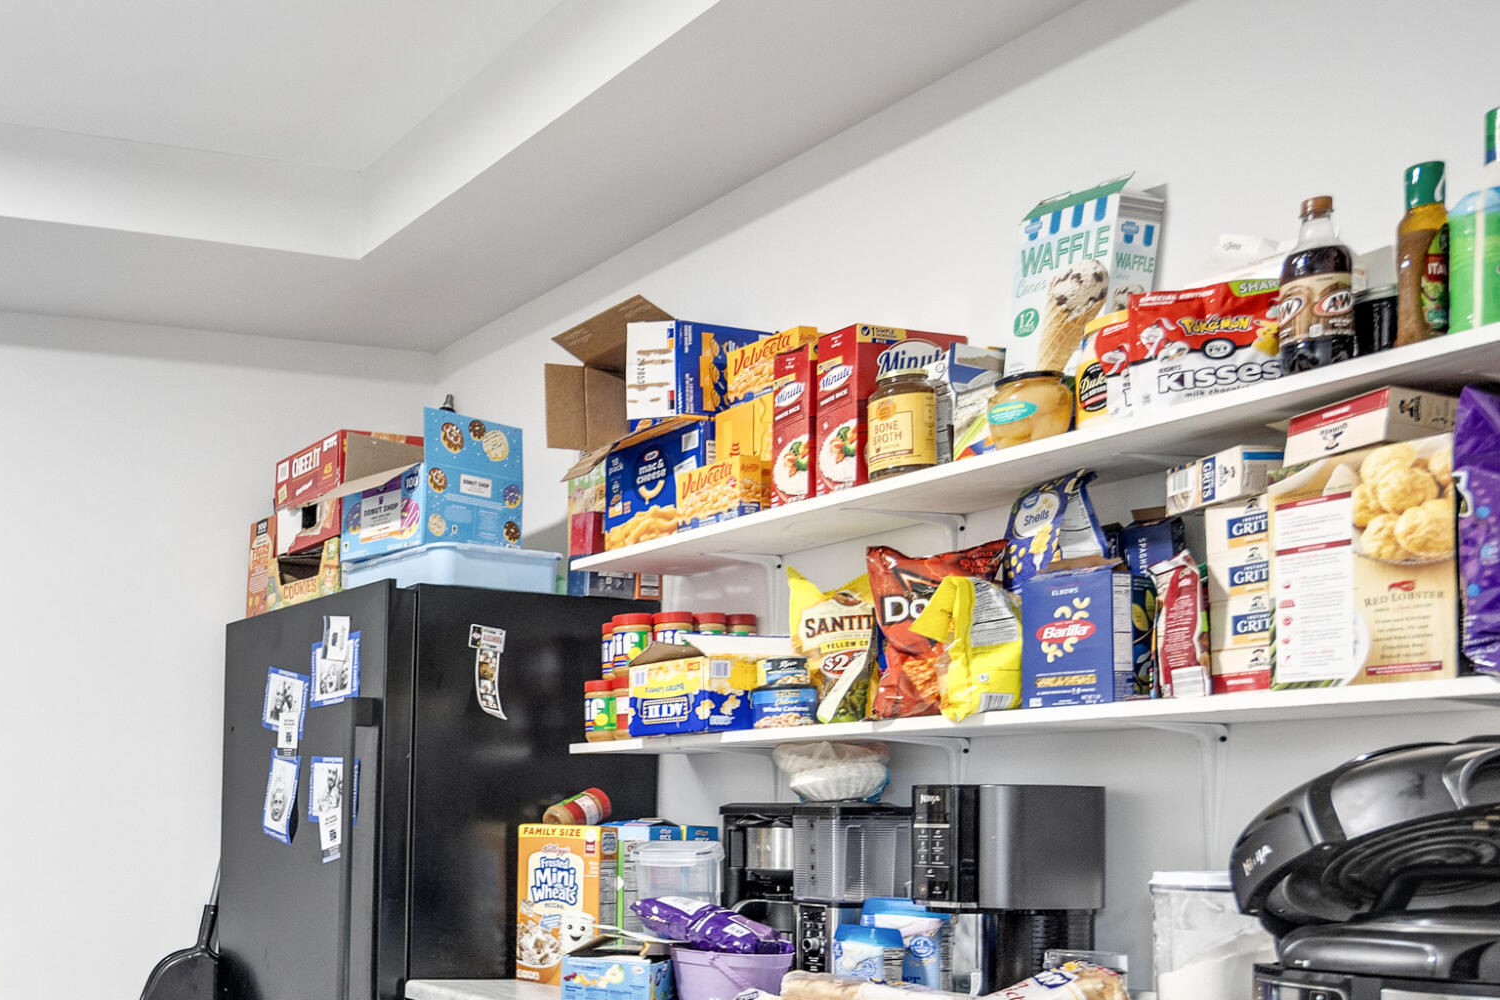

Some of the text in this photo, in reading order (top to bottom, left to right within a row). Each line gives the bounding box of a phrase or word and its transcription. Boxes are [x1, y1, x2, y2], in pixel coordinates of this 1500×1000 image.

[1020, 225, 1110, 278] WAFFLE
[1115, 252, 1154, 273] WAFFLE
[1428, 263, 1447, 276] ITA
[1239, 279, 1280, 295] SHAR
[1018, 310, 1035, 328] 12
[733, 334, 791, 376] Velveeta
[878, 348, 947, 376] Minut
[822, 366, 851, 389] Minute
[874, 420, 899, 435] BONE
[873, 430, 902, 446] BROTH
[682, 463, 733, 500] Velveeta
[1202, 461, 1213, 499] GRITS
[1023, 509, 1049, 526] Shells
[1231, 519, 1268, 536] GRIT
[1233, 568, 1269, 585] GRIT
[283, 578, 318, 600] COOKIES
[1391, 591, 1444, 602] LOBSTER
[804, 614, 873, 639] SANTIT
[1042, 623, 1093, 640] Barilla
[1236, 618, 1270, 634] GRIT
[826, 640, 857, 649] YELLOW
[647, 702, 684, 719] ACT II
[523, 827, 581, 837] FAMILY SIZE
[540, 856, 570, 869] Frosted
[534, 867, 576, 888] Mini
[531, 884, 578, 906] Wheats
